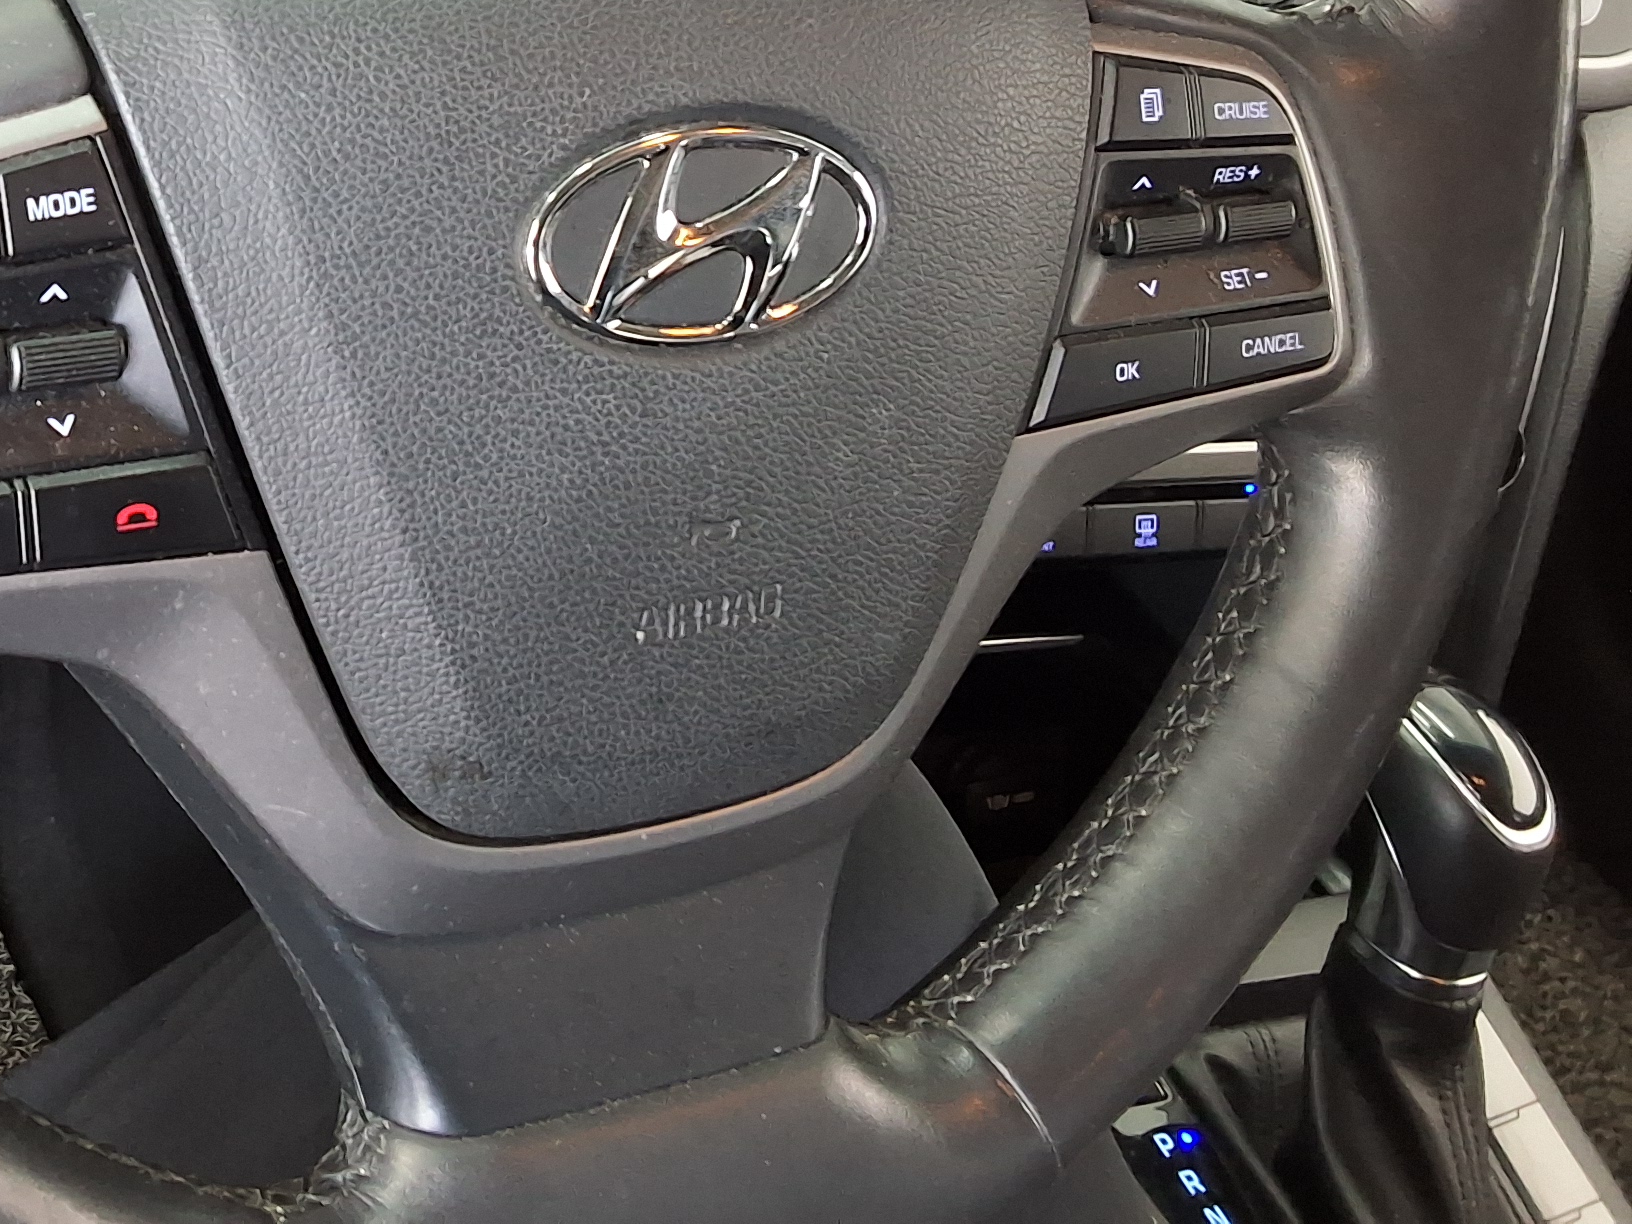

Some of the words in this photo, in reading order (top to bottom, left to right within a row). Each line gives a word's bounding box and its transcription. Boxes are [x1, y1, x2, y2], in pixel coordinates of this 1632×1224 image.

[1213, 101, 1270, 121] CRUISE
[26, 187, 97, 222] MODE
[1241, 332, 1305, 358] CANCEL
[1115, 361, 1141, 383] OK
[1152, 1132, 1175, 1158] P
[1177, 1169, 1207, 1197] R
